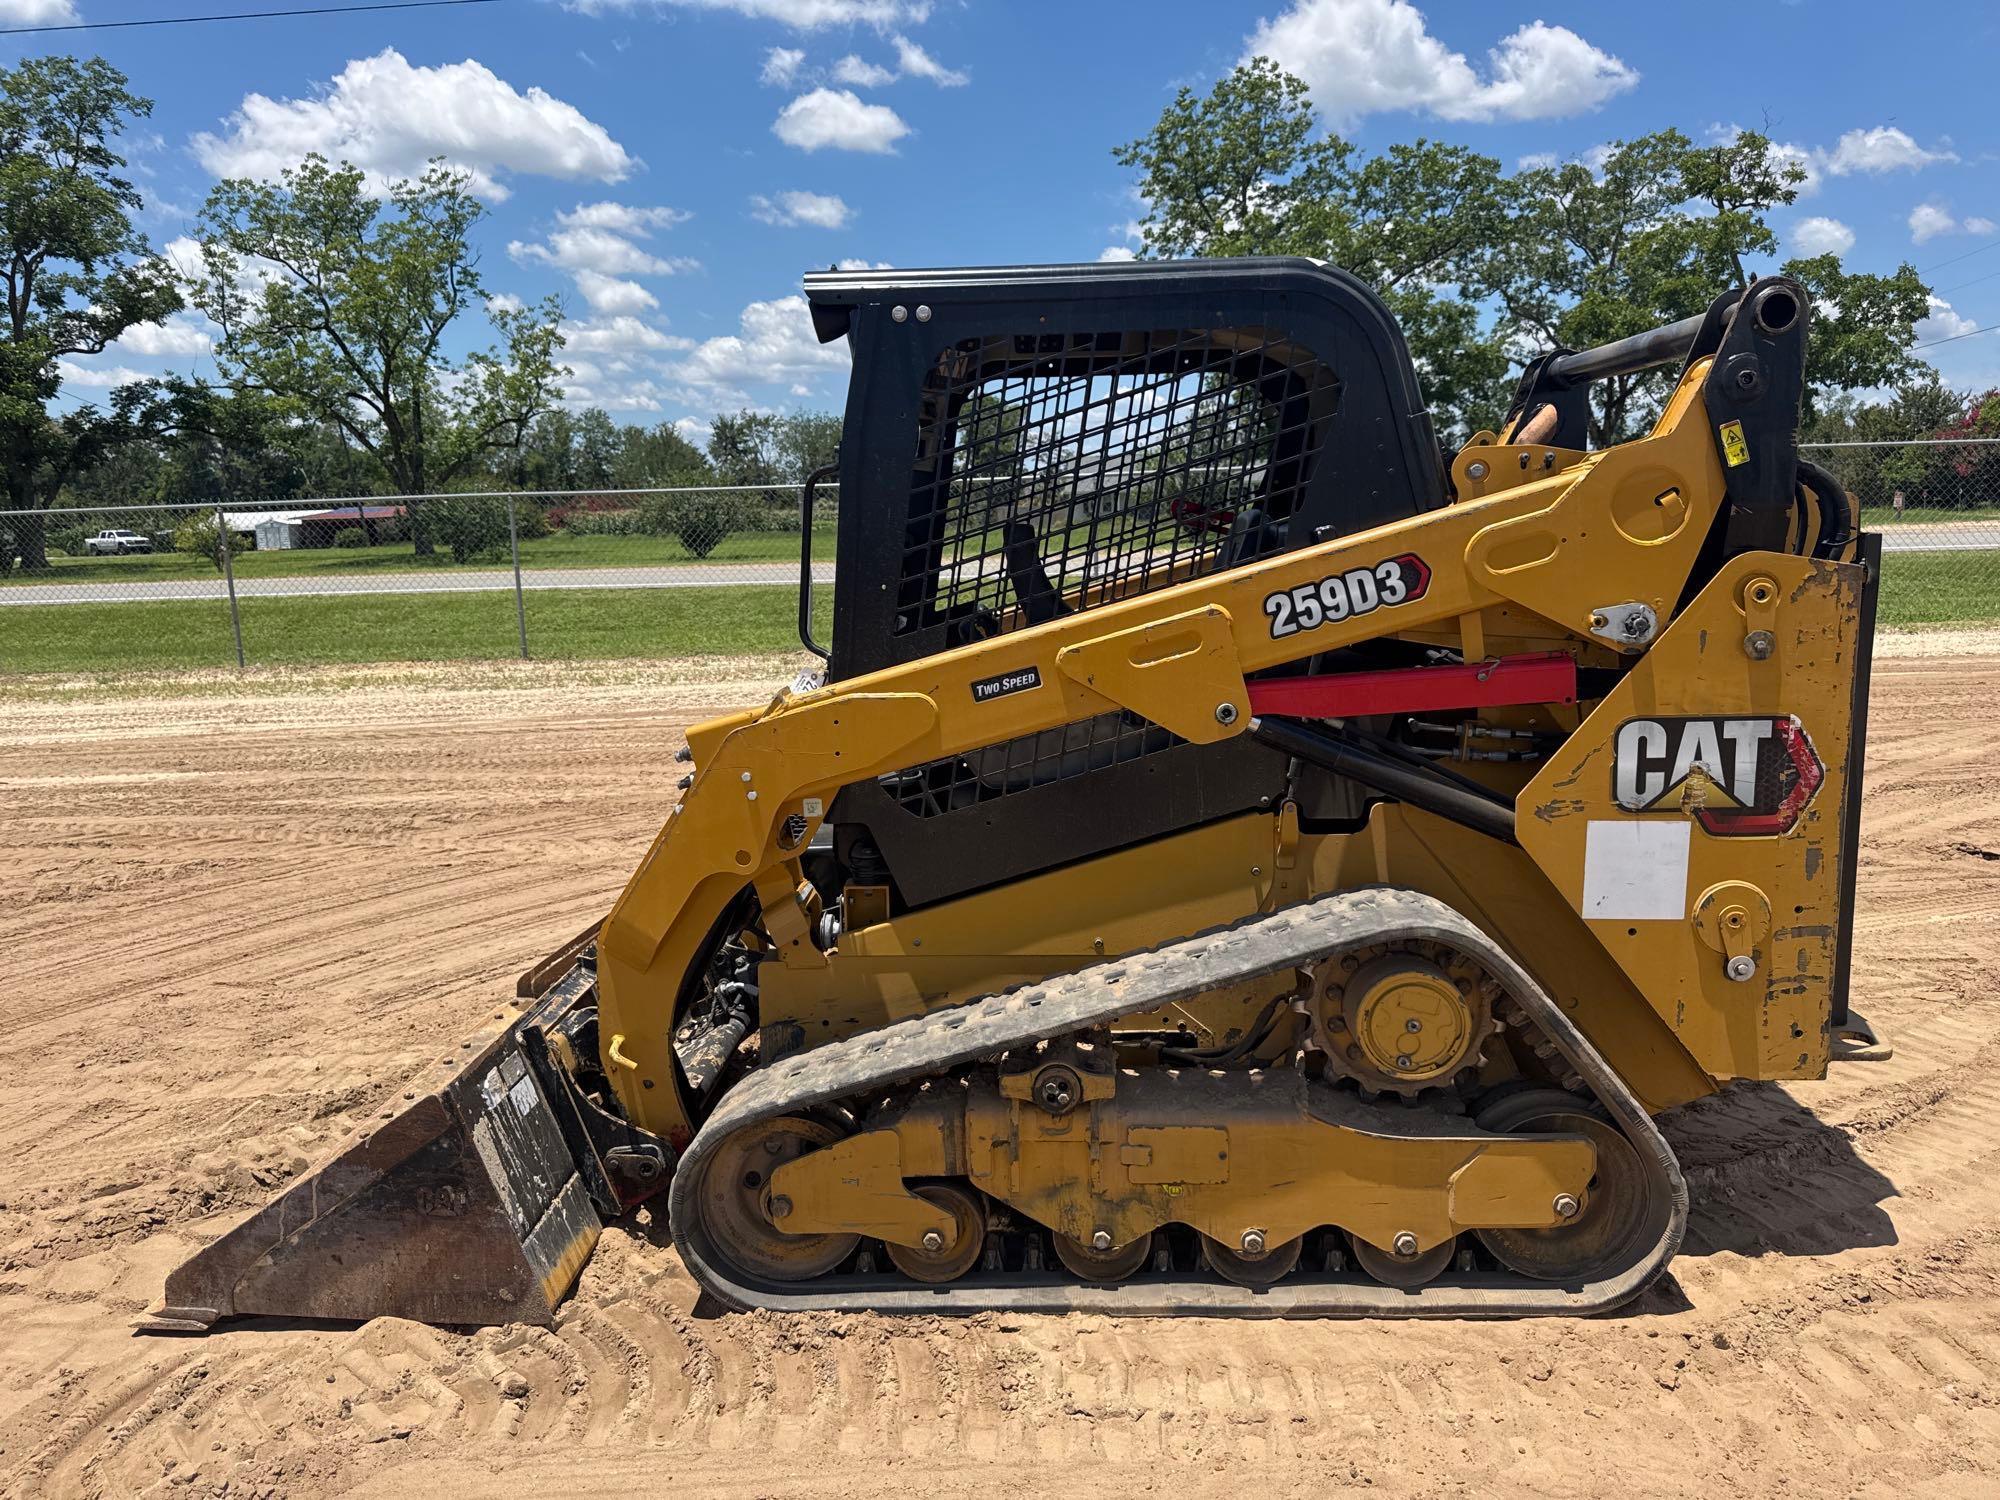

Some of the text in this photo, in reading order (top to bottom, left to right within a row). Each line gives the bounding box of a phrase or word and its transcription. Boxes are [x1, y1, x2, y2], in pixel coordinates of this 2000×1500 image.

[1266, 561, 1407, 637] 259D3
[976, 673, 1035, 697] TWO SPEED
[1617, 720, 1773, 809] CAT
